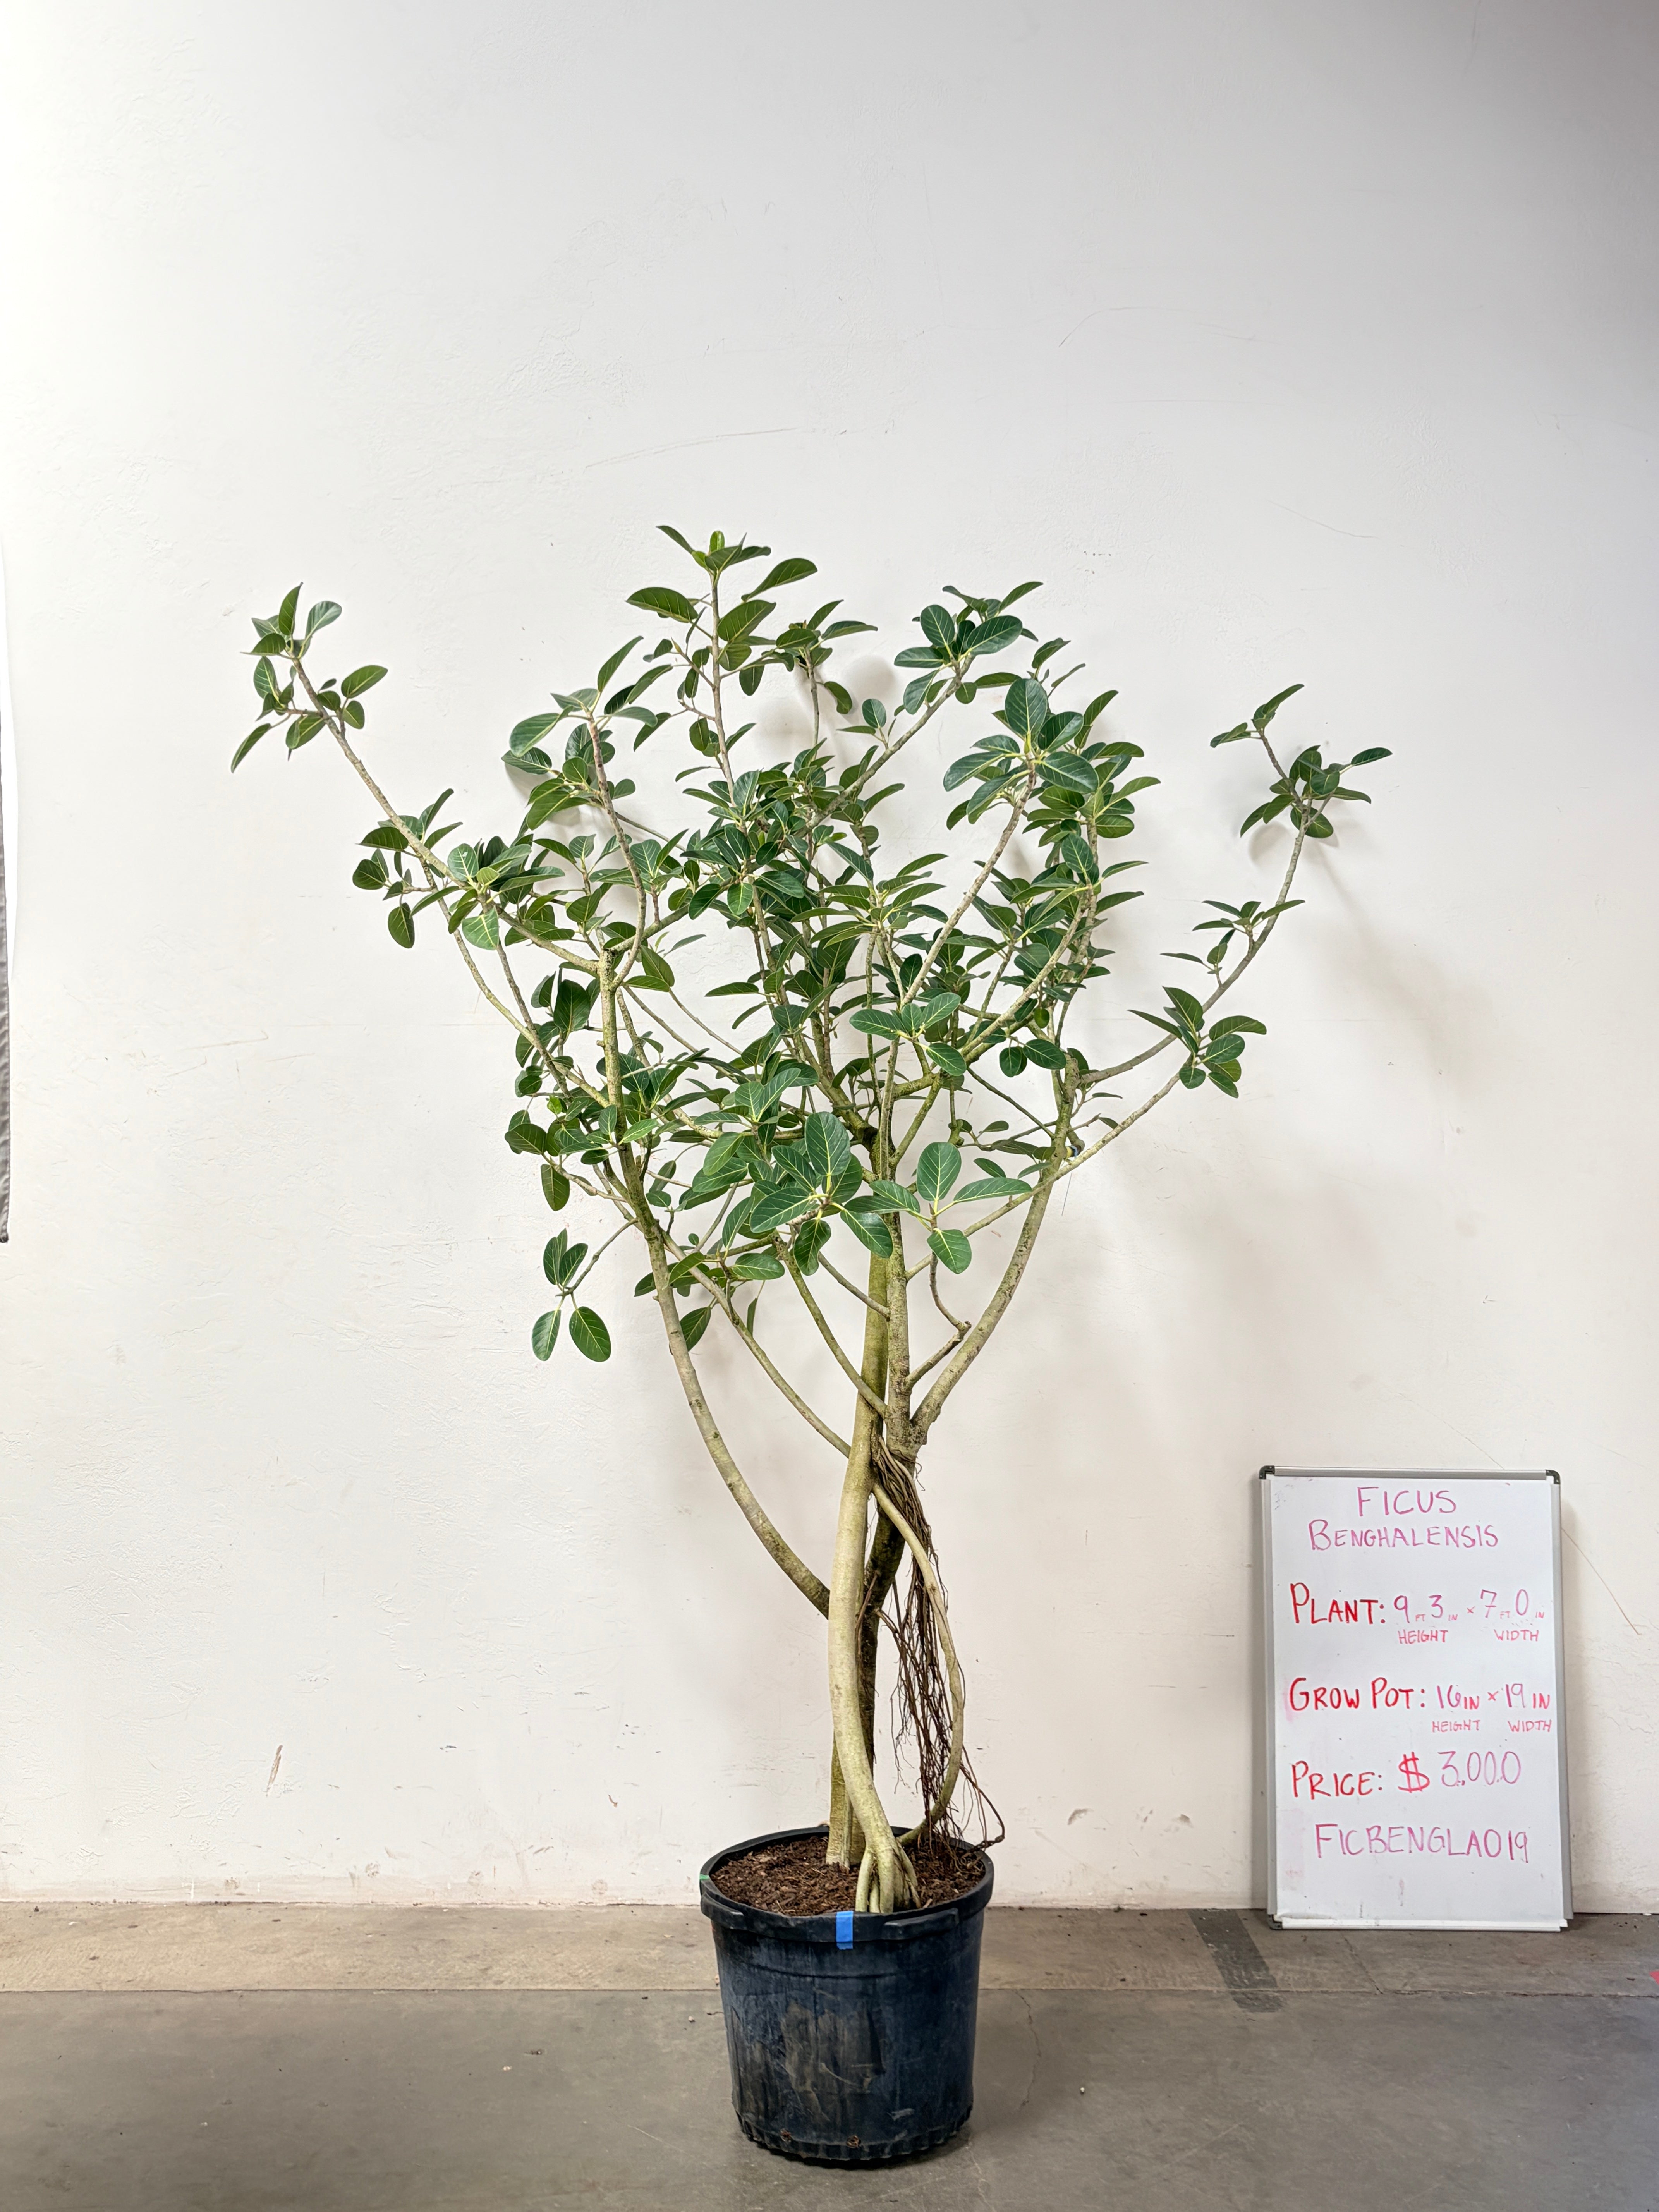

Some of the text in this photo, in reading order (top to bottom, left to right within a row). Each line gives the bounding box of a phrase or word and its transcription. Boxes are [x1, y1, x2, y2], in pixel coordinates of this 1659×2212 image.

[1357, 1486, 1456, 1516] FICUS
[1308, 1519, 1498, 1551] BENGHALENSIS
[1290, 1582, 1386, 1625] PLANT:
[1394, 1595, 1410, 1623] 9
[1428, 1594, 1444, 1618] 3
[1480, 1589, 1497, 1618] 7
[1398, 1629, 1539, 1644] HEIGHT WIDTH
[1290, 1677, 1360, 1711] GROW
[1370, 1677, 1425, 1709] POT:
[1432, 1719, 1552, 1733] HEIGHT WIDTH
[1291, 1760, 1382, 1800] PRICE:
